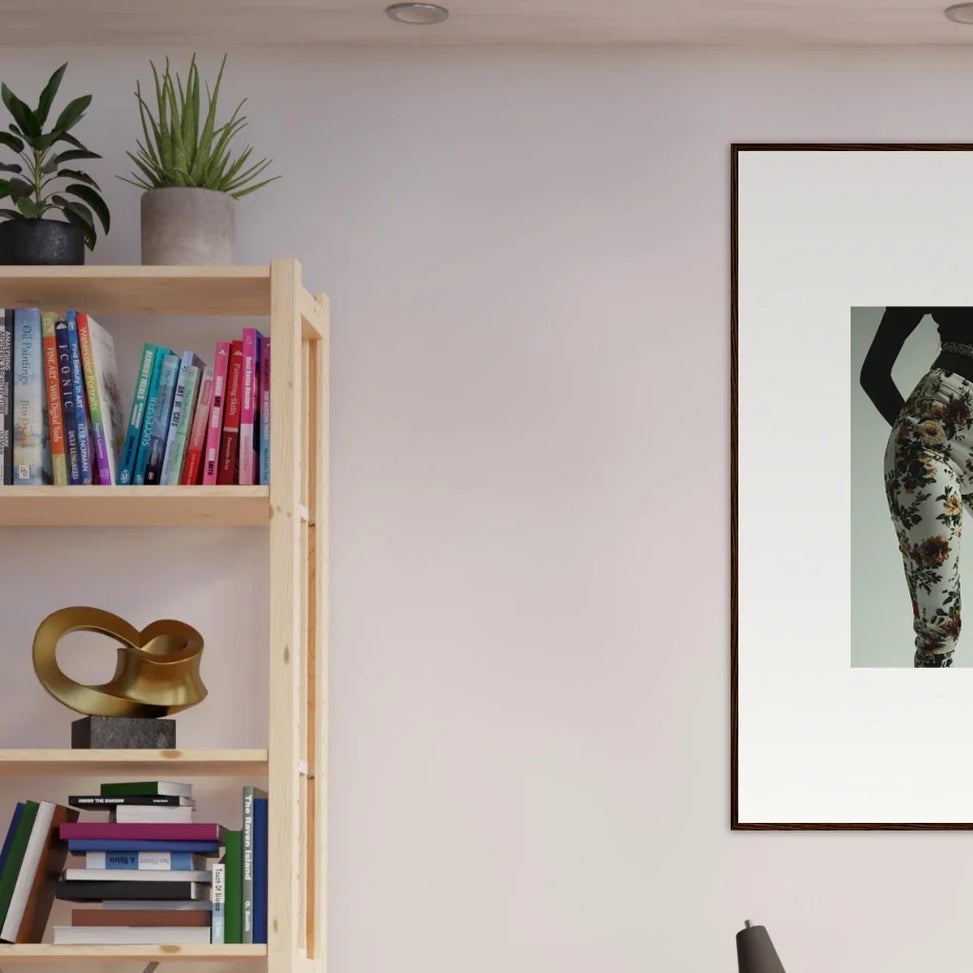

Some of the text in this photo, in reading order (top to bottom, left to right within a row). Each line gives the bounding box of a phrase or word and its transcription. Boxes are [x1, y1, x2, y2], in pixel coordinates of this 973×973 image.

[18, 325, 32, 386] Oil Paintings
[47, 347, 56, 363] FINE
[48, 364, 57, 379] ART
[80, 327, 92, 374] Watercolor
[87, 375, 98, 412] Portraits
[59, 344, 73, 409] ICONIC
[229, 363, 241, 416] Parenting Skills
[50, 385, 59, 402] With
[48, 402, 60, 425] Digital
[142, 397, 157, 447] SUCCESSFUL
[52, 425, 61, 443] Tools
[79, 439, 89, 472] NORMAN
